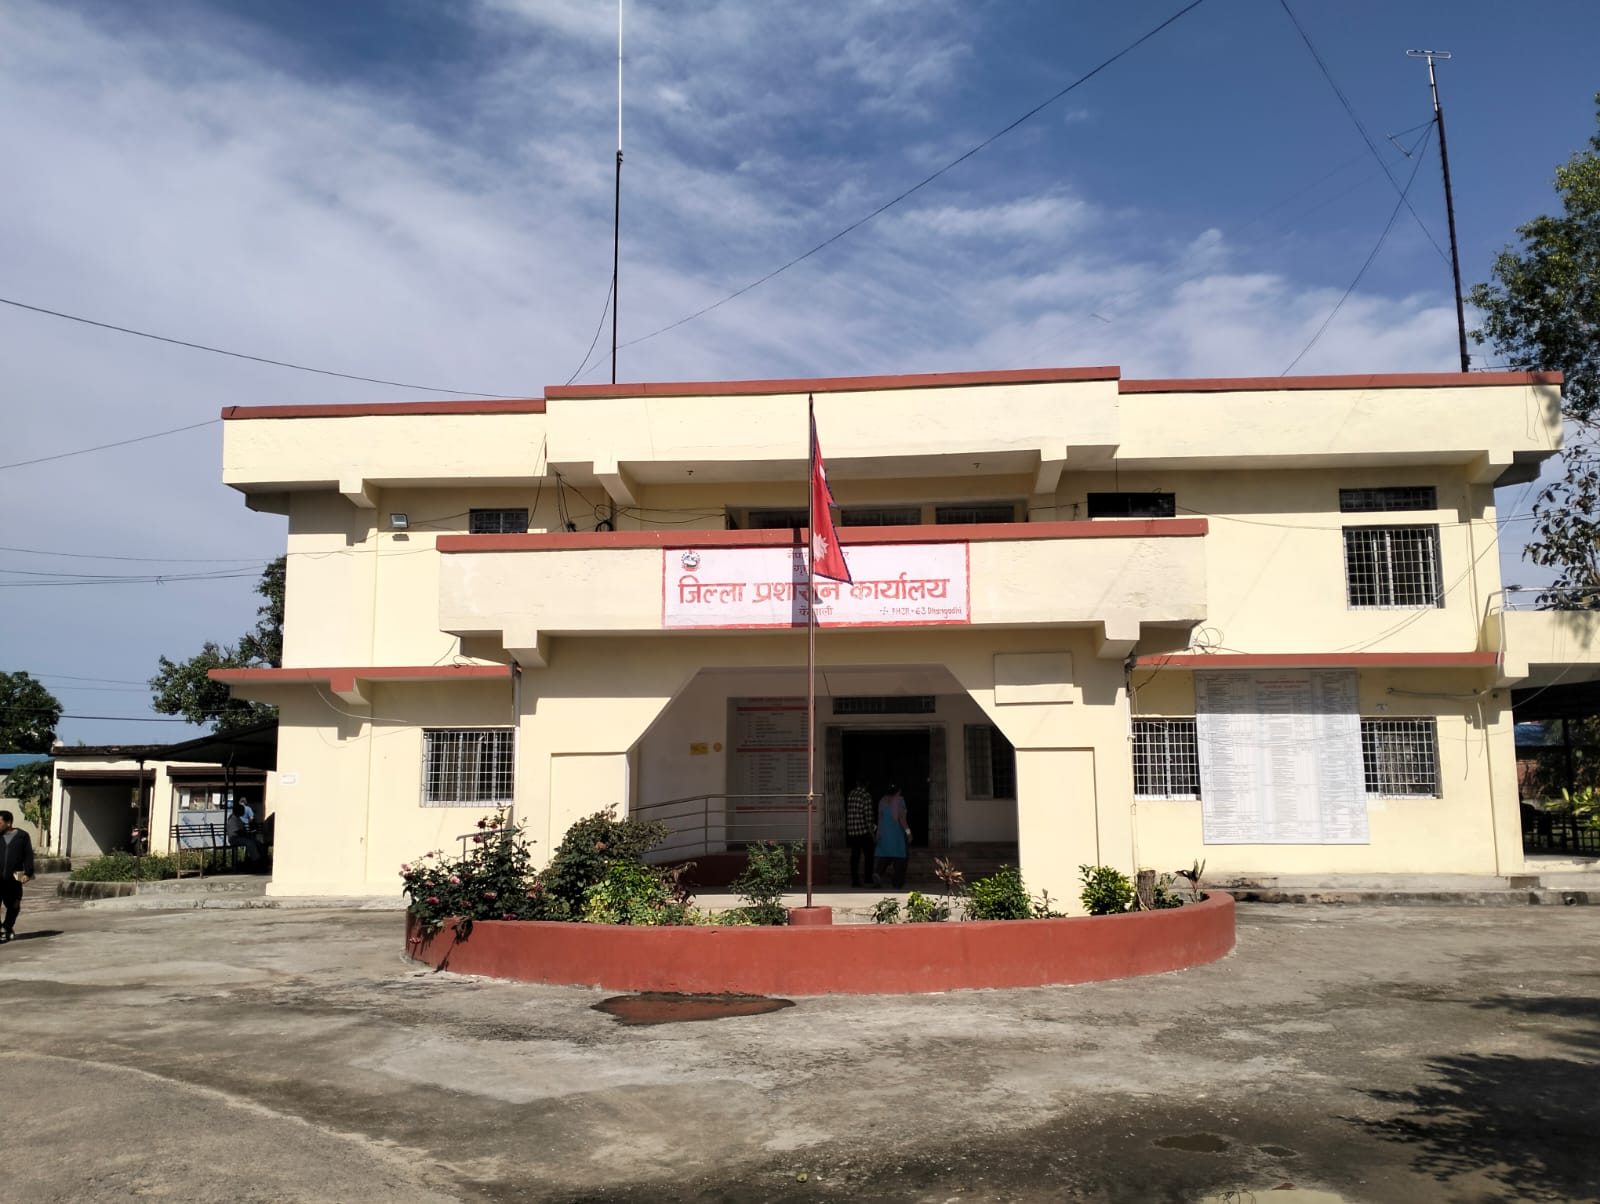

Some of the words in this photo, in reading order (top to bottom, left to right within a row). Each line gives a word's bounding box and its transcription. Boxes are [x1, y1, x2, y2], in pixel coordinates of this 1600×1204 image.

[678, 574, 746, 604] जिल्ला
[752, 581, 843, 604] प्रशासन
[849, 572, 950, 601] कार्यालय
[798, 605, 834, 616] कैाली
